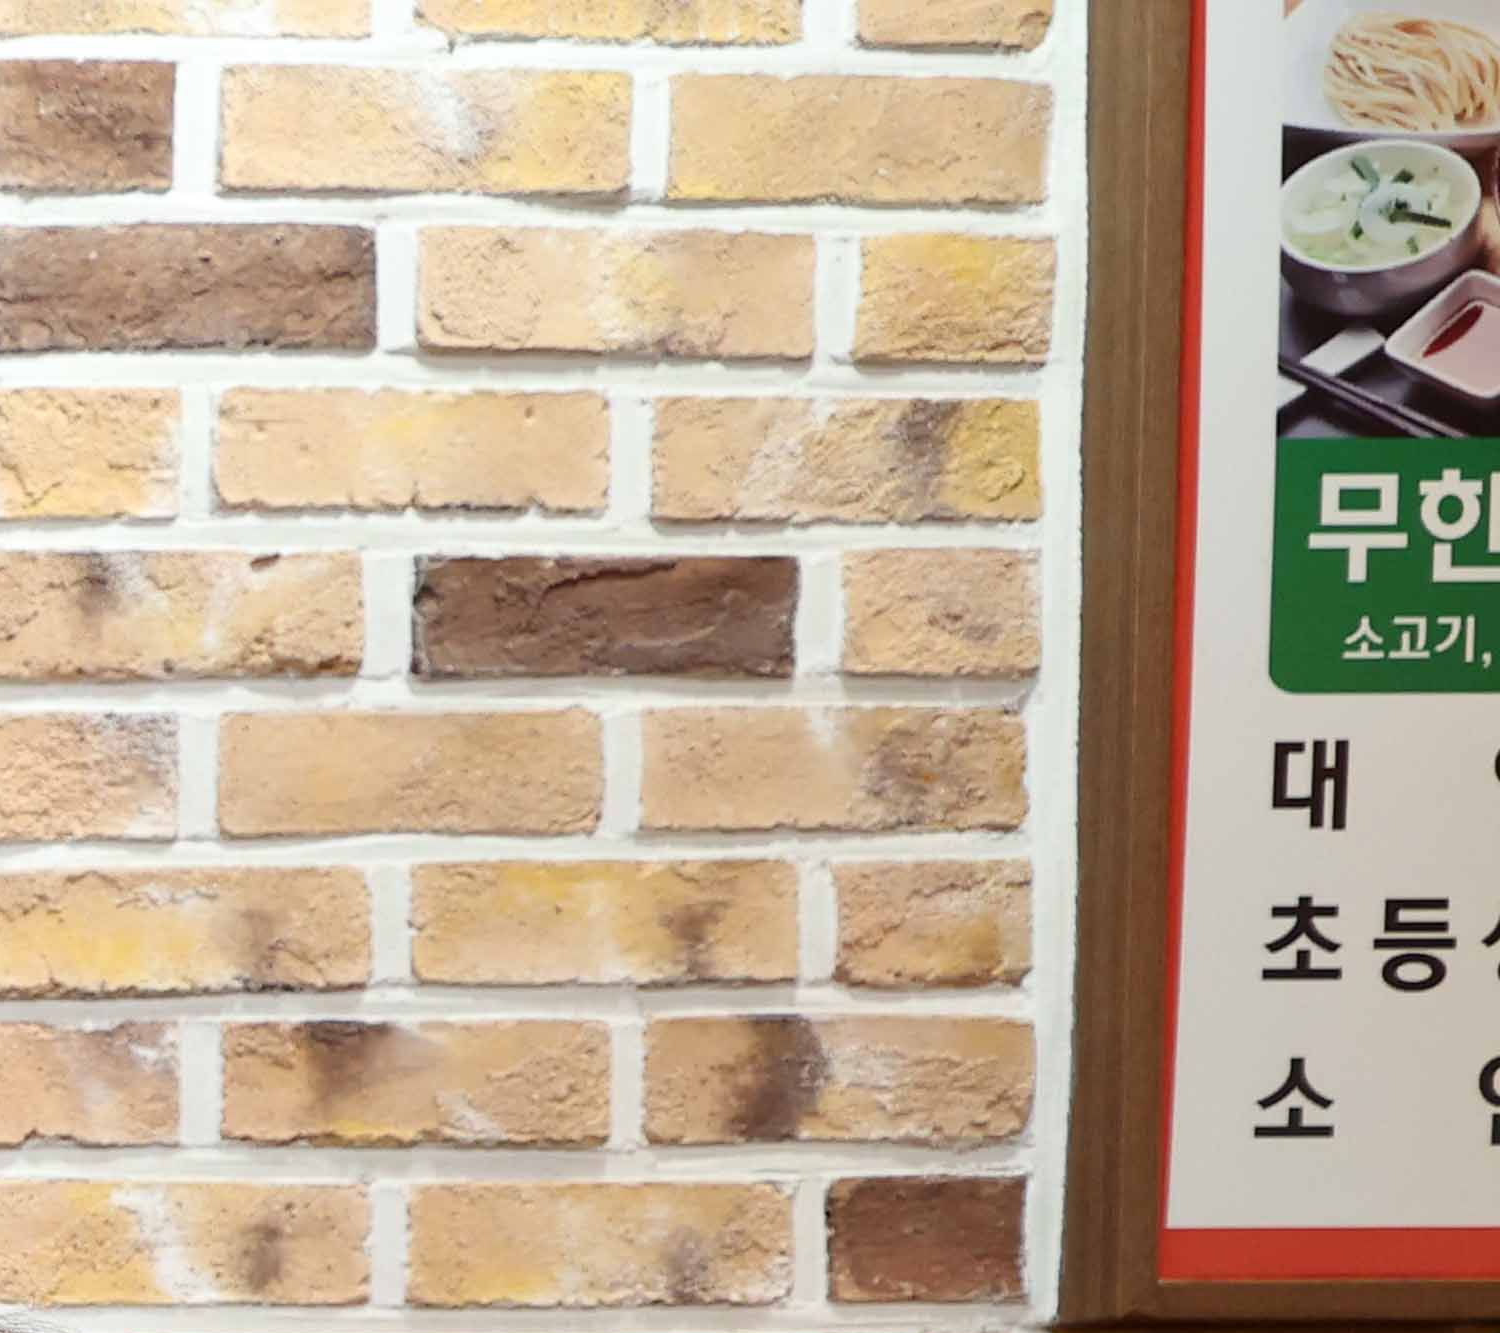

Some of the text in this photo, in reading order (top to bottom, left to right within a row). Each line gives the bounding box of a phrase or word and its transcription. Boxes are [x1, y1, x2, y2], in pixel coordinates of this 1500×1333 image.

[1308, 468, 1500, 584] 무한
[1341, 614, 1492, 668] 소고기,
[1261, 896, 1500, 993] 초등
